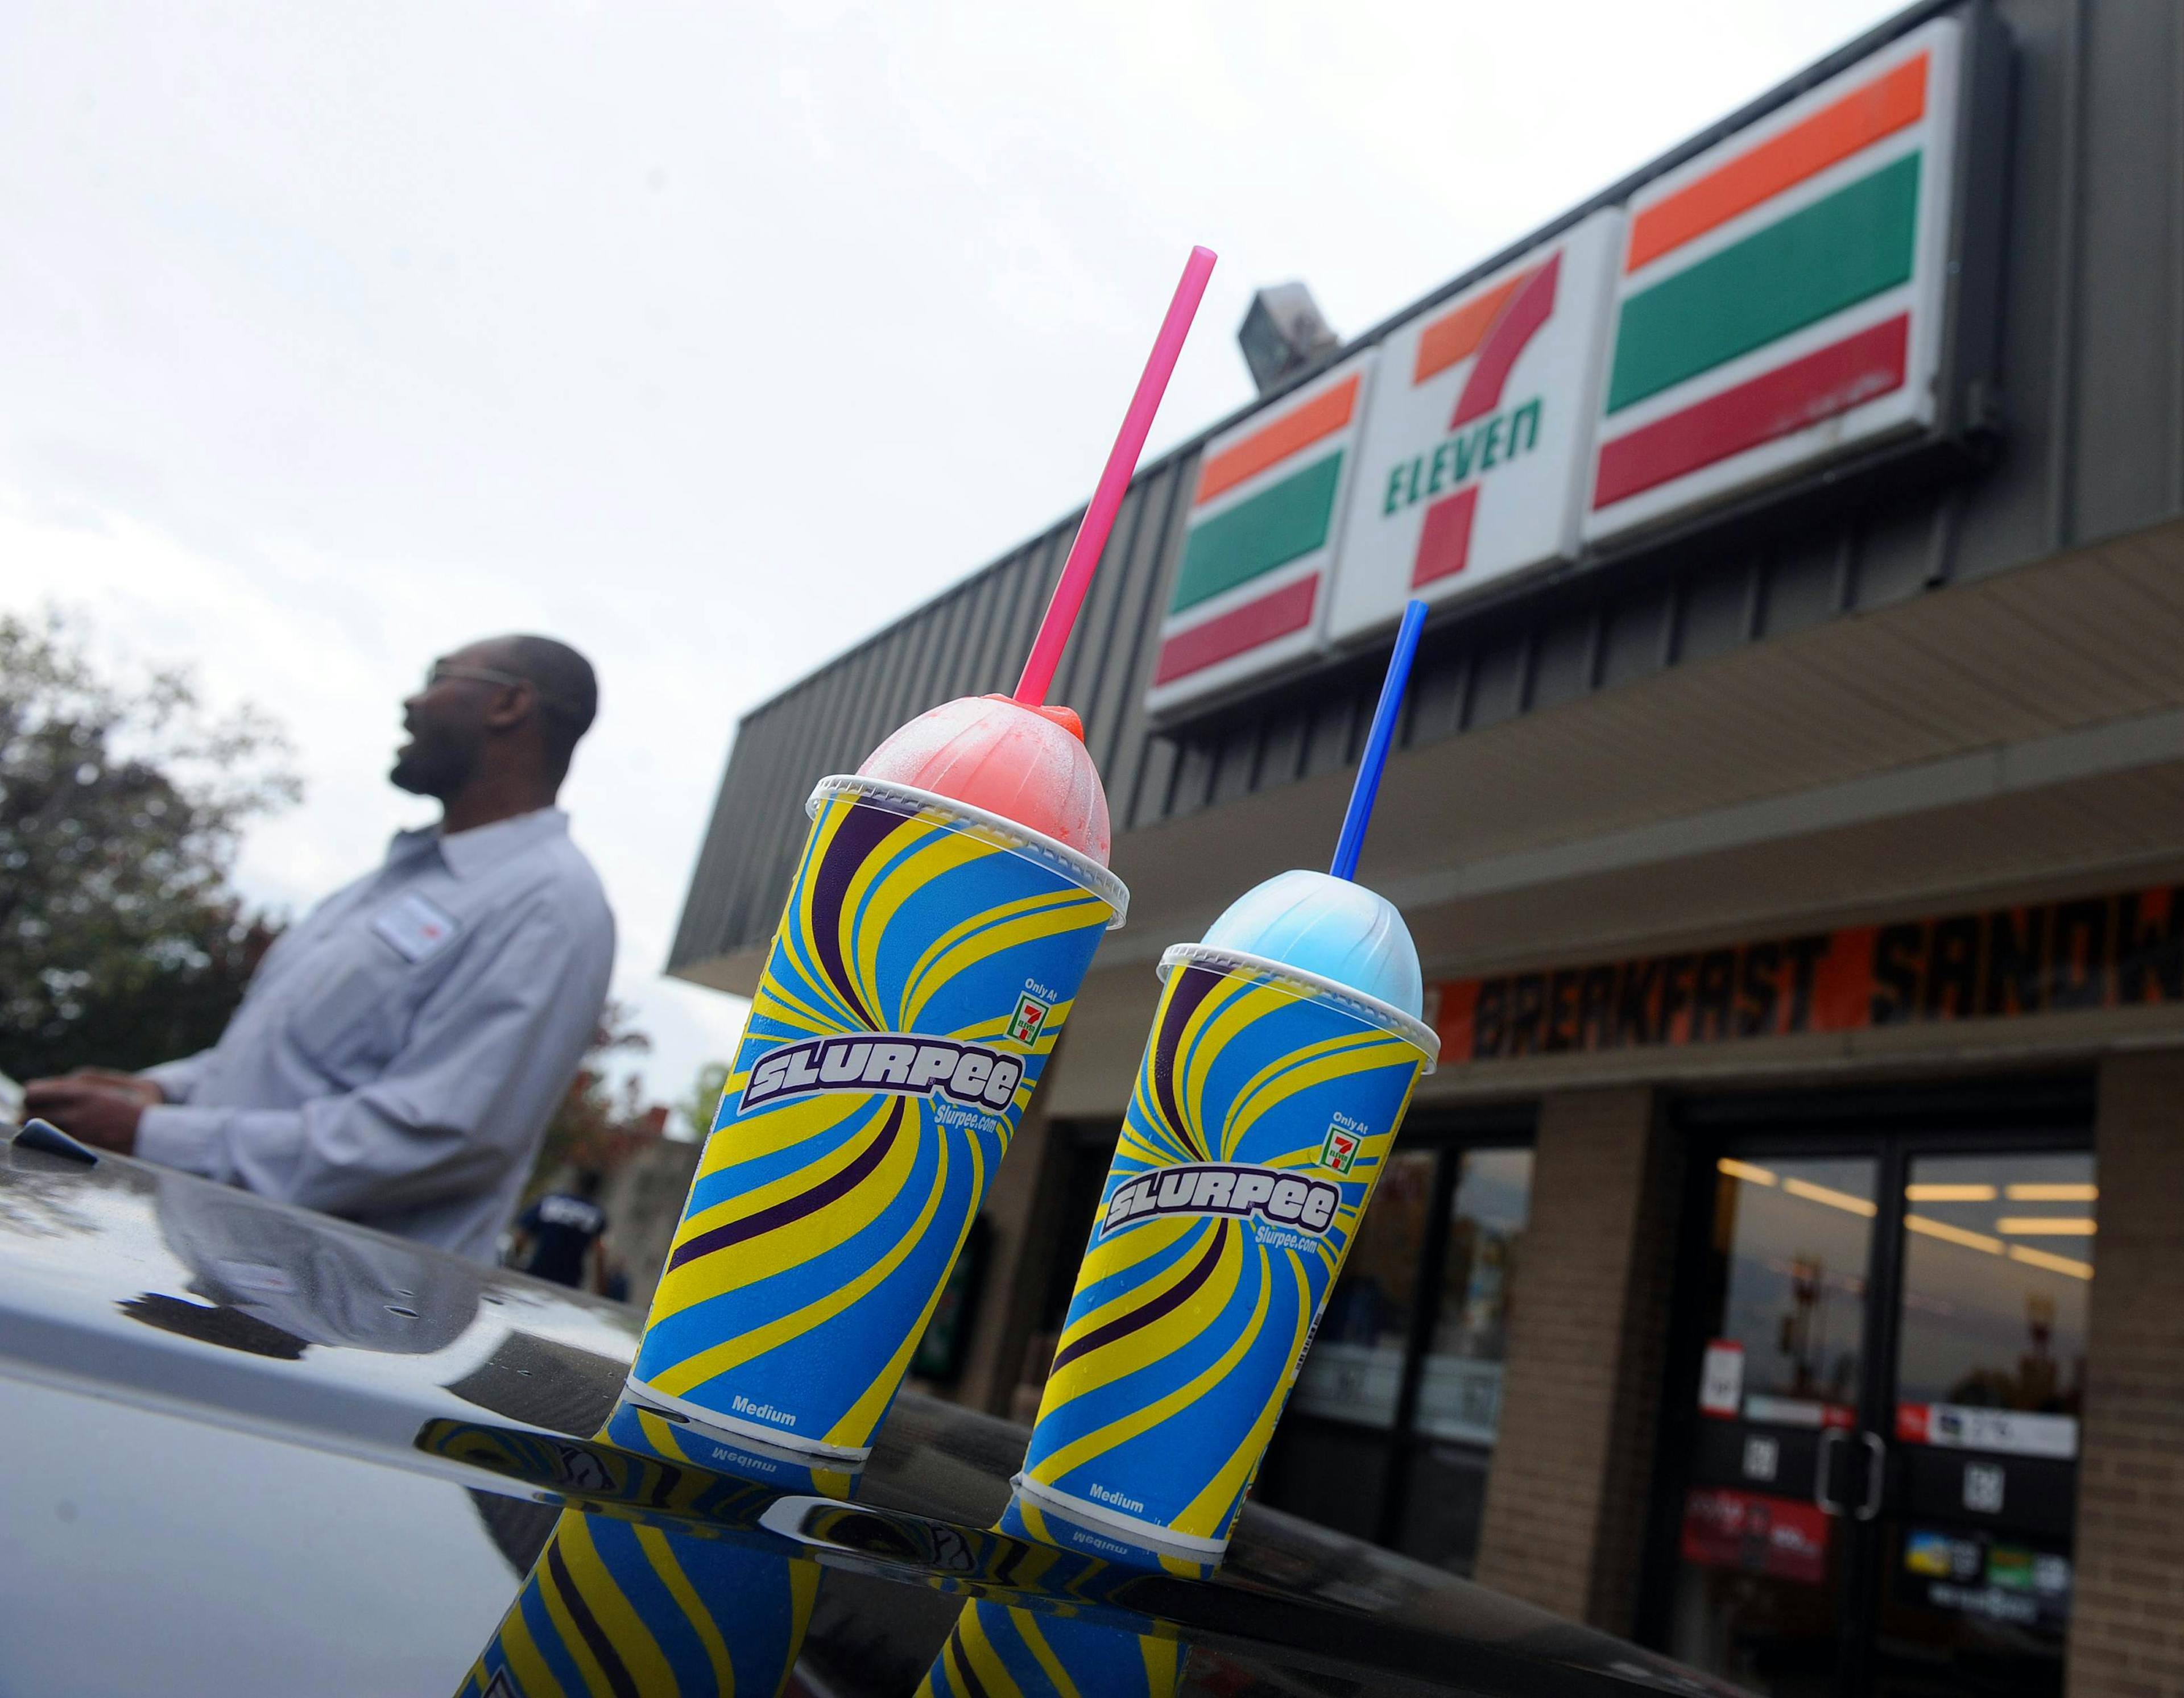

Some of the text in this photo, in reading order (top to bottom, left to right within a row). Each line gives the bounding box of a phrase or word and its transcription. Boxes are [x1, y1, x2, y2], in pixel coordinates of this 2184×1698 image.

[1412, 248, 1564, 591] 7
[1024, 978, 1058, 1002] Only At
[1473, 933, 1829, 1058] BREAKFAST
[934, 1104, 997, 1133] Slurpee.com
[1333, 1111, 1368, 1134] Only At
[1255, 1225, 1318, 1254] Slurpee.com
[731, 1395, 796, 1427] Medium
[1089, 1483, 1144, 1514] Medium
